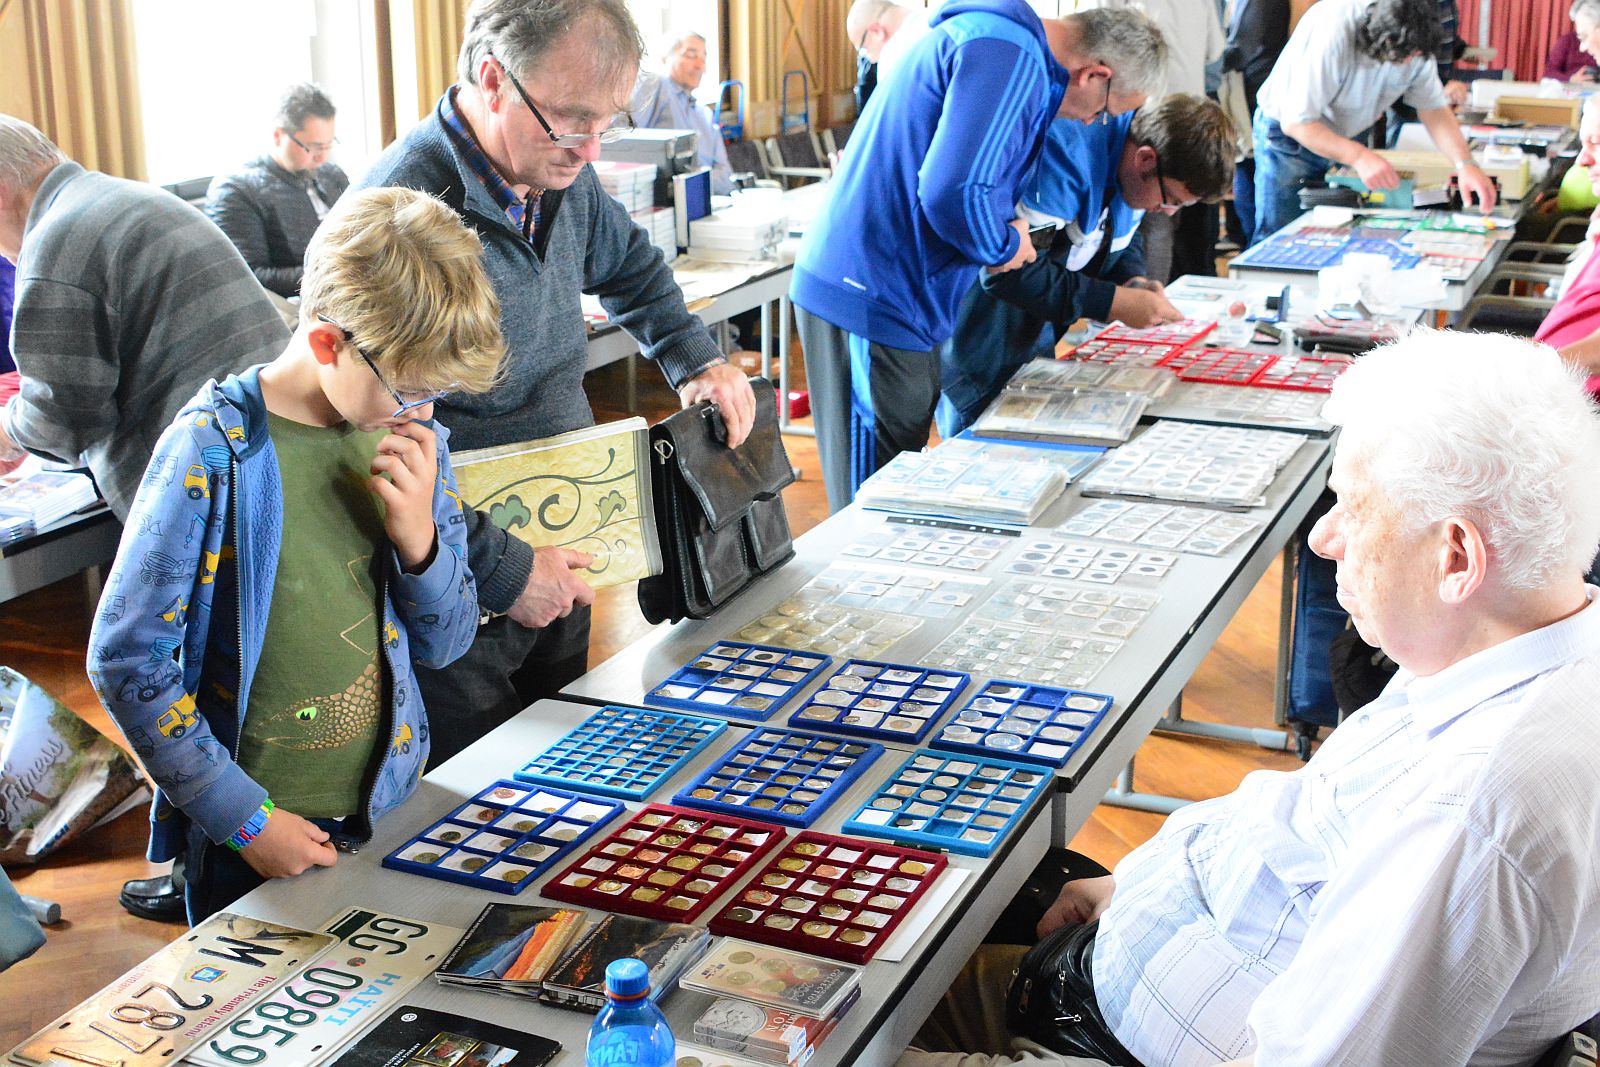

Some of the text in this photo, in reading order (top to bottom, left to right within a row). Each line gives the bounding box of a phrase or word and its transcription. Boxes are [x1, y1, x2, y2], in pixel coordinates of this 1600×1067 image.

[197, 935, 284, 968] M
[349, 917, 428, 956] GG
[184, 975, 278, 1038] The Friendly Island
[210, 967, 364, 1065] 09859
[323, 972, 402, 1027] HAÏTI
